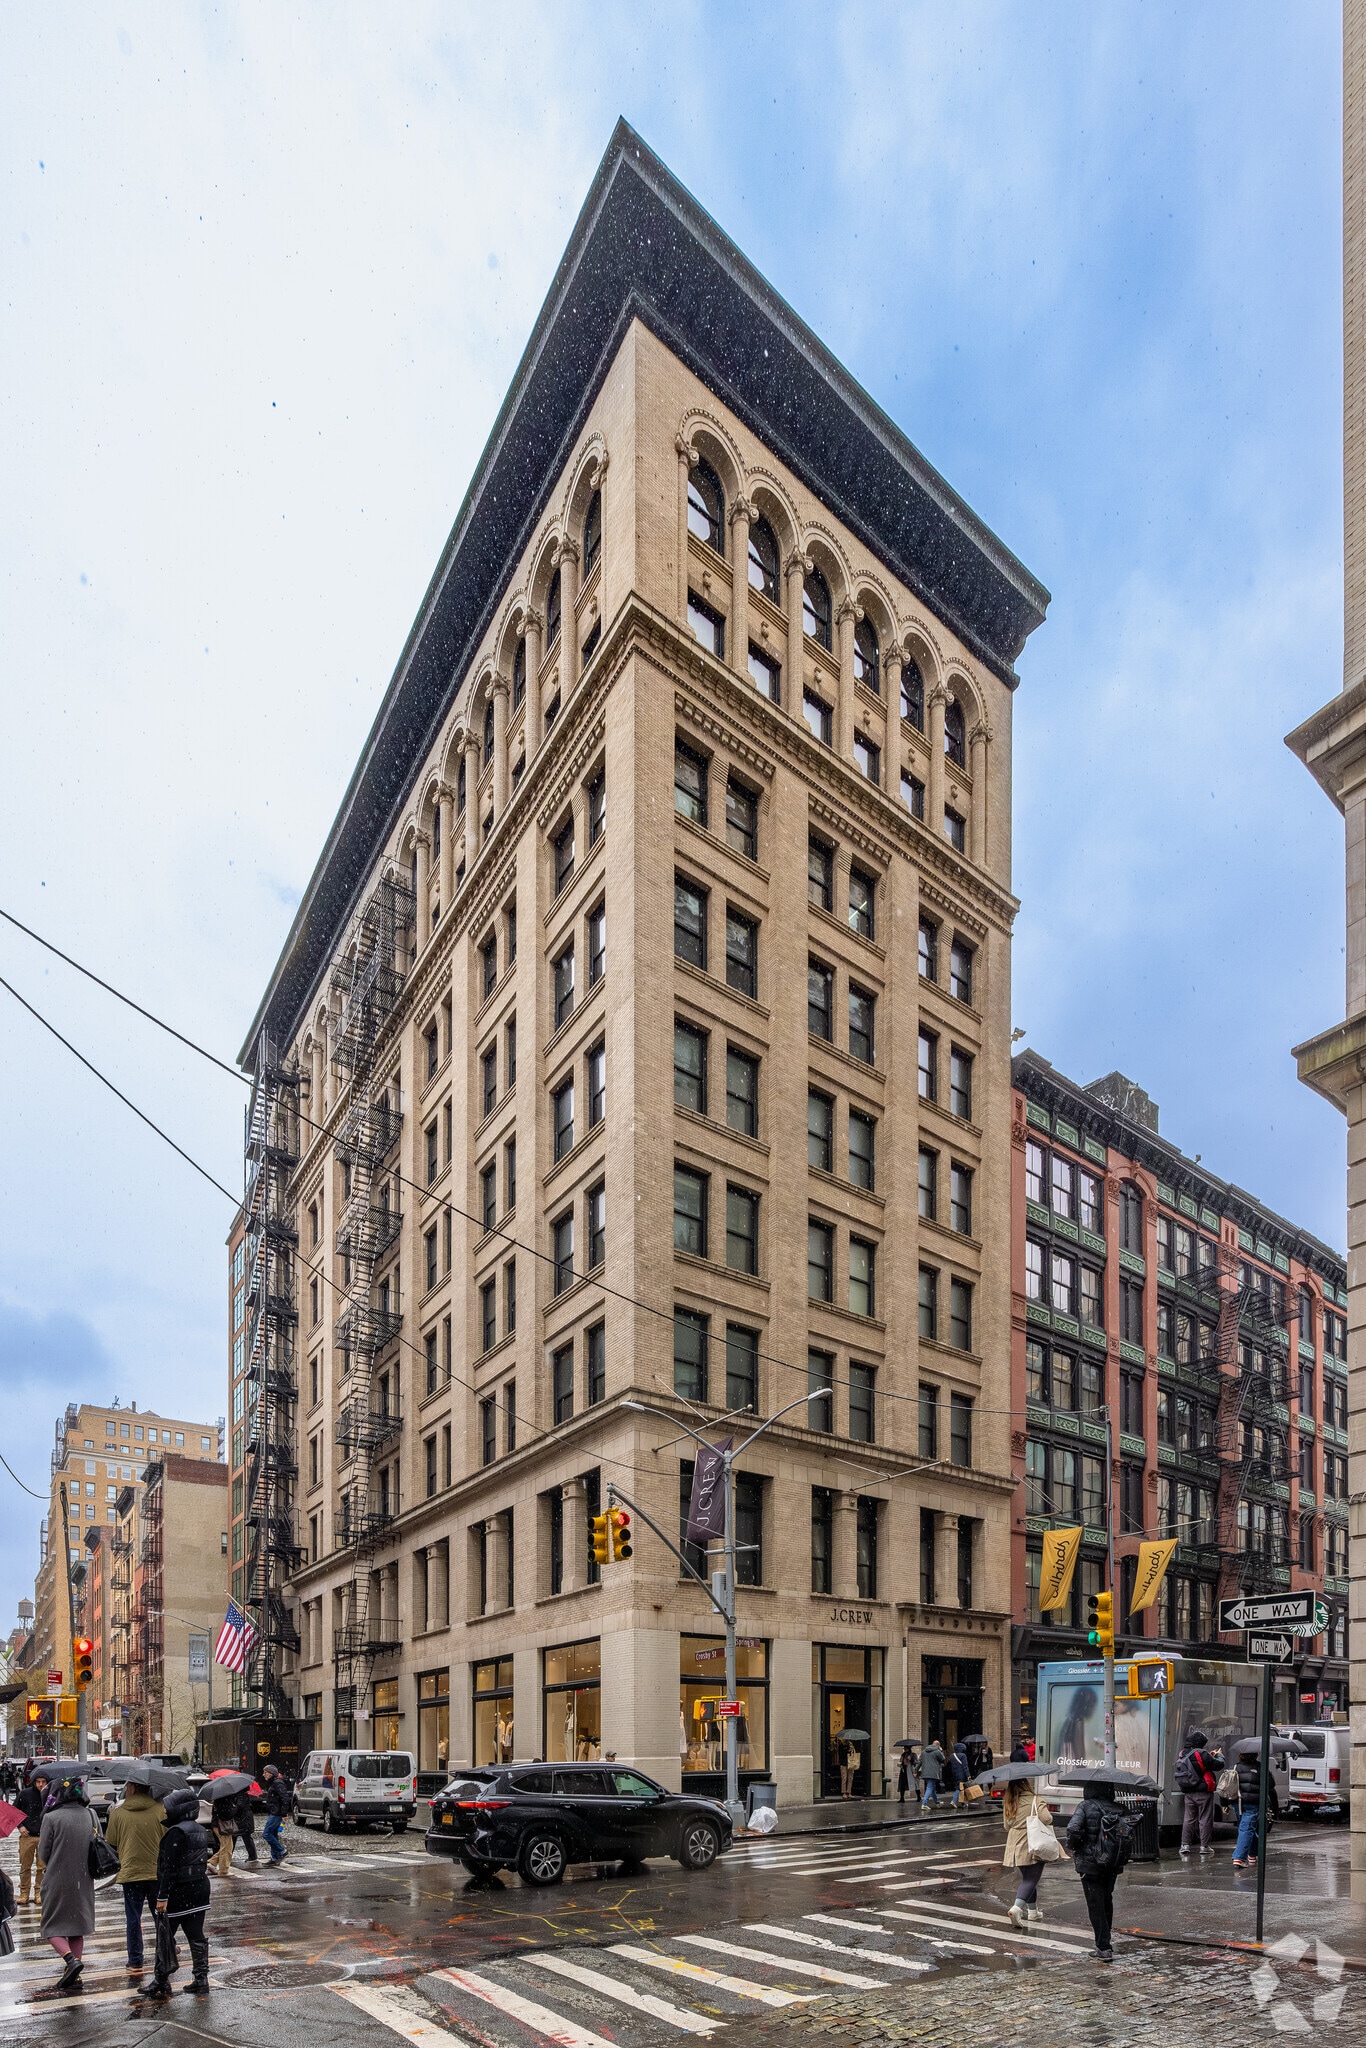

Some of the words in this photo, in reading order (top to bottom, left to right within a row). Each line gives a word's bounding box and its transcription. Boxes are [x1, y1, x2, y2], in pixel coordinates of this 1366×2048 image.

[697, 1457, 717, 1526] J.CREW
[1052, 1540, 1070, 1598] allbirds
[831, 1608, 873, 1623] J.CREW
[1233, 1607, 1259, 1620] ONE
[1272, 1603, 1301, 1617] WAY
[695, 1651, 711, 1660] Crosby
[711, 1650, 717, 1658] St
[1255, 1641, 1269, 1653] ONE
[1273, 1641, 1288, 1654] WAY
[1057, 1757, 1092, 1767] Glossier
[1094, 1759, 1106, 1768] yo
[1116, 1760, 1141, 1768] FLEUR
